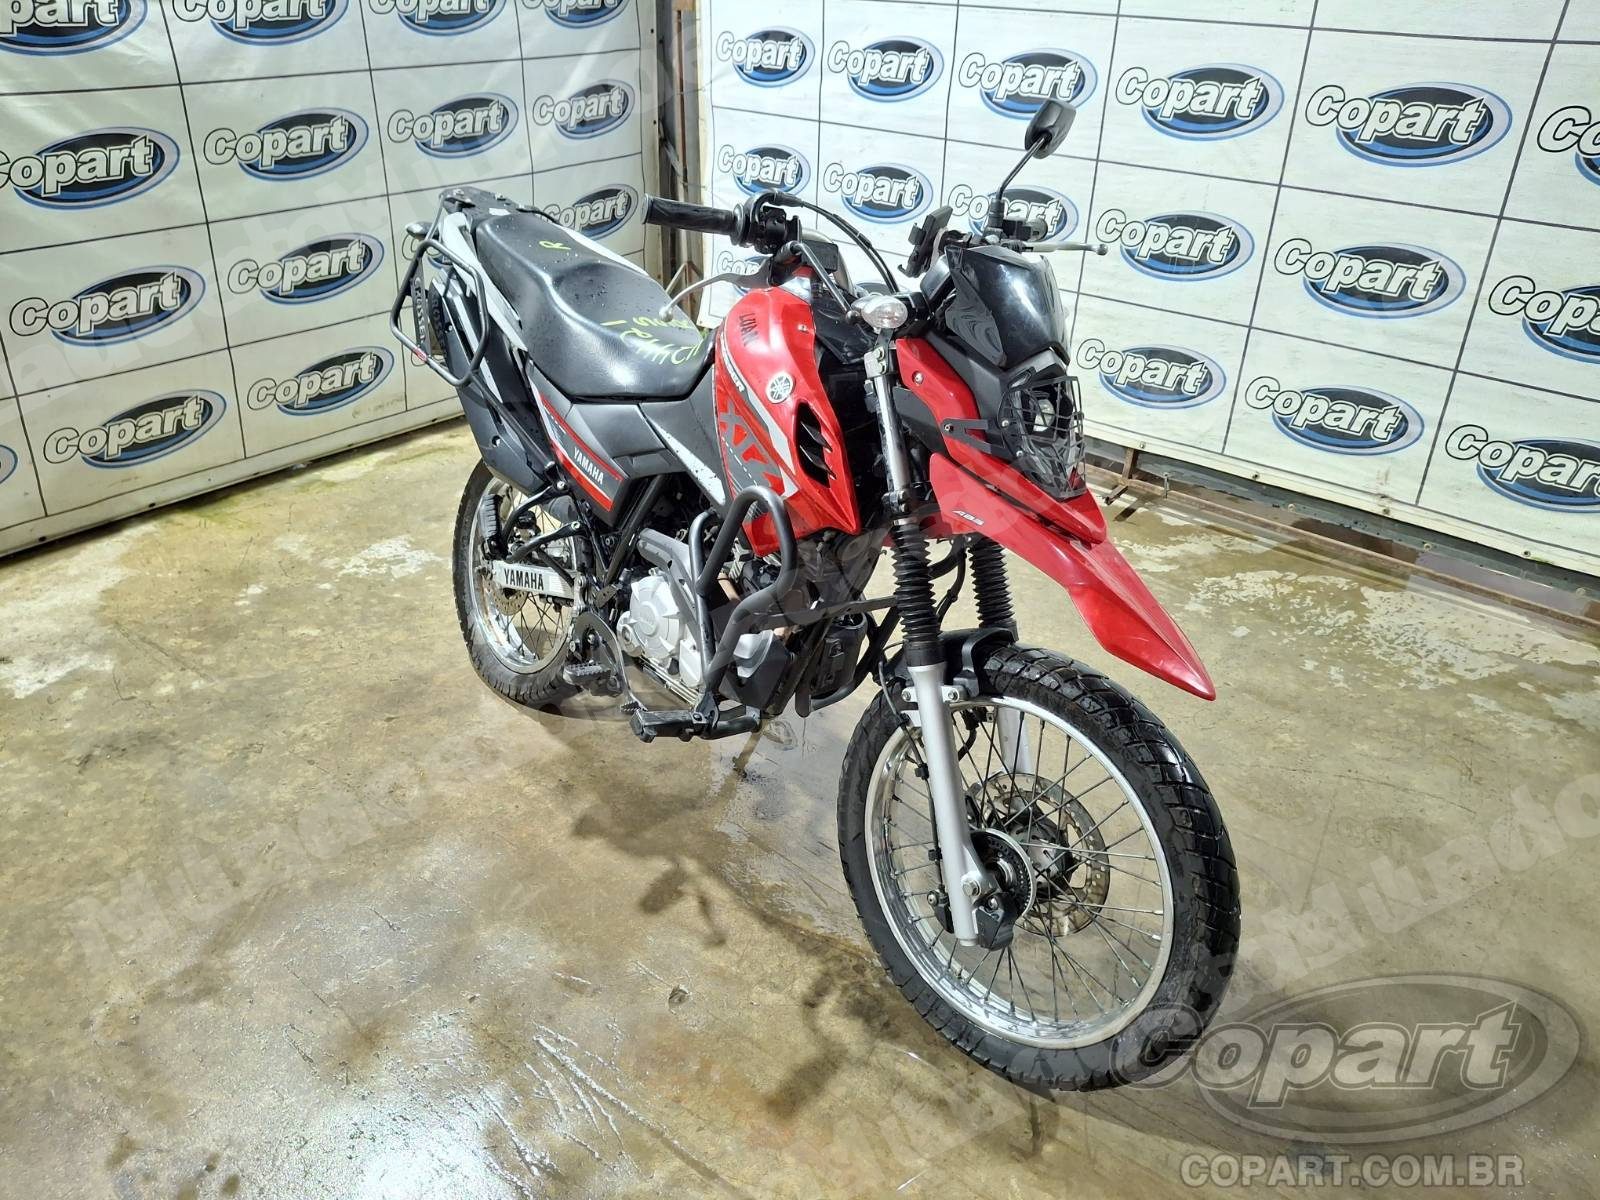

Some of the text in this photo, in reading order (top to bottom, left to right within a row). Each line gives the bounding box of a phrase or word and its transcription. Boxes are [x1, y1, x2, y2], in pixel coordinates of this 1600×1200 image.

[716, 31, 804, 71] Copart
[827, 40, 931, 86] Copart
[958, 51, 1081, 101] Copart
[533, 86, 624, 127] Copart
[1115, 66, 1263, 119] Copart
[1305, 84, 1487, 144] Copart
[203, 115, 350, 170] Copart
[387, 99, 504, 149] Copart
[0, 134, 154, 196] opart
[717, 144, 802, 189] Copart
[823, 162, 920, 210] Copart
[947, 183, 1064, 235] Coart
[1096, 208, 1237, 264] Copart
[227, 238, 366, 295] Copart
[1273, 237, 1442, 301] Copart
[9, 271, 182, 337] Copart
[245, 351, 377, 411] Copart
[1075, 337, 1206, 396] Copart
[43, 394, 205, 464] Copart
[1245, 375, 1405, 442] Copart
[573, 446, 605, 485] YAMAHA
[1445, 424, 1600, 496] Copar
[503, 571, 545, 592] YAMAHA
